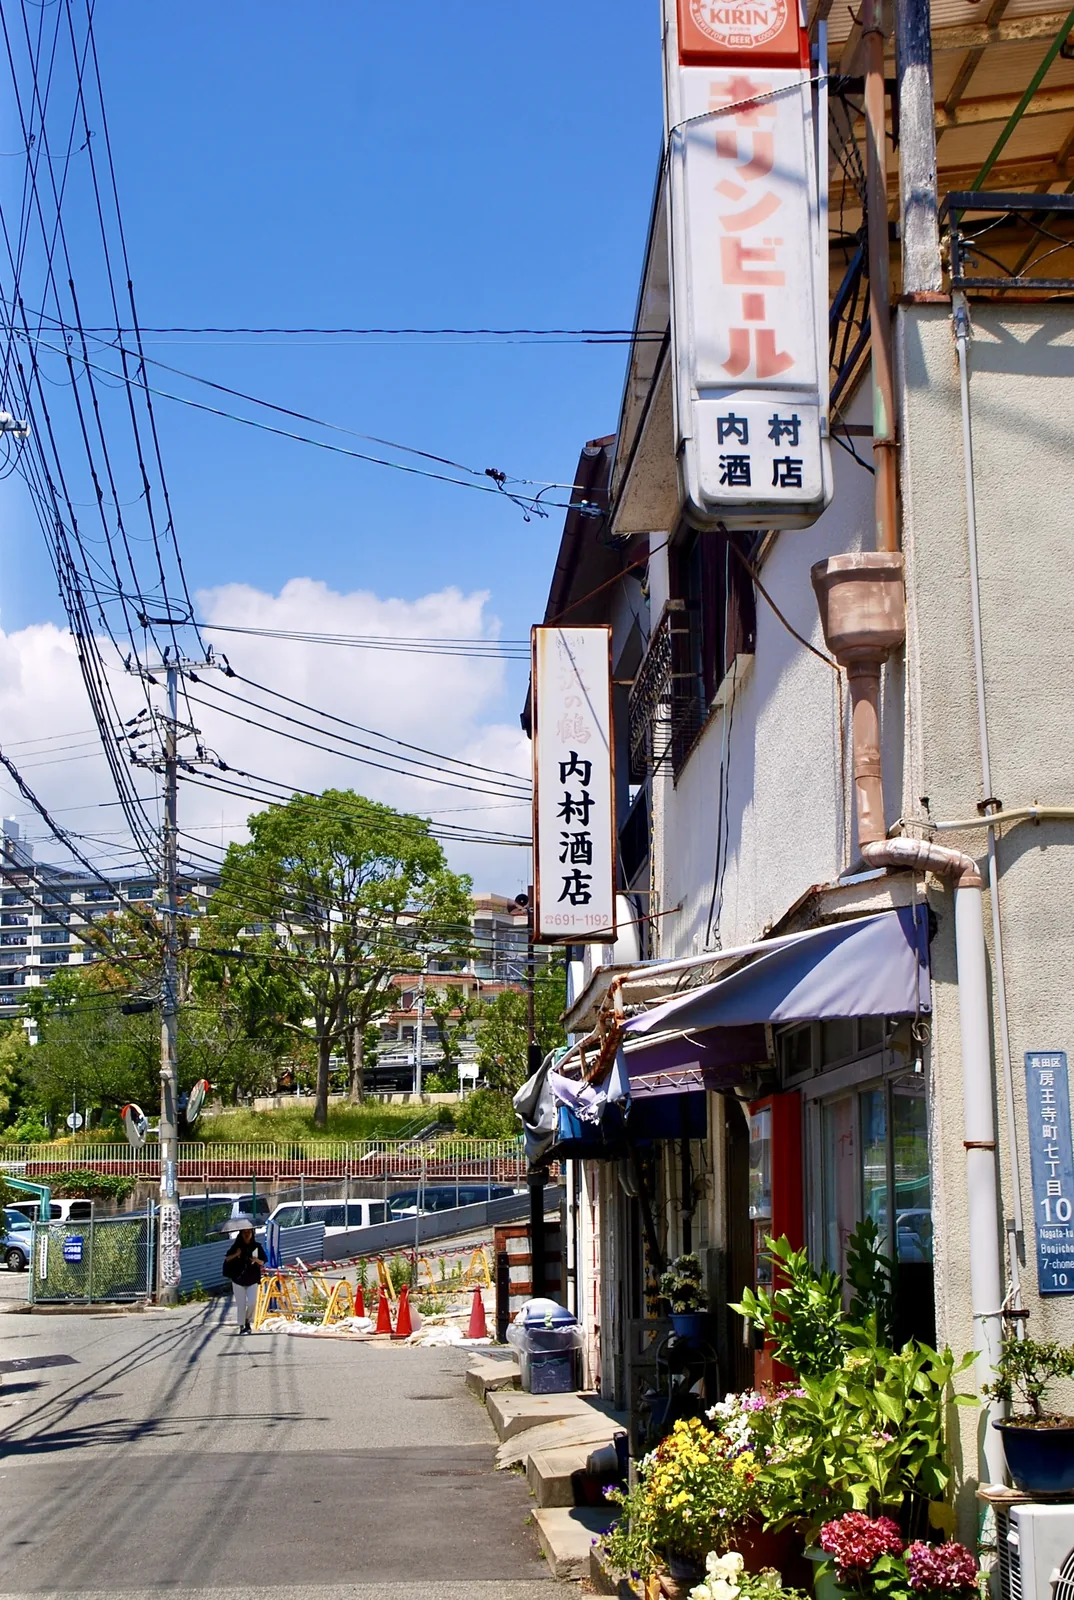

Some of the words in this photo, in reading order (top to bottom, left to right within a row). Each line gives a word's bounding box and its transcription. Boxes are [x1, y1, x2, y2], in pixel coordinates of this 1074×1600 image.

[709, 8, 769, 26] KIRIN
[730, 35, 751, 44] BEER
[708, 75, 796, 379] キリンビール
[716, 412, 802, 447] 内村
[718, 454, 804, 489] 酒店
[556, 750, 596, 907] 内村酒店
[1031, 1057, 1061, 1068] 長田区
[1038, 1070, 1062, 1196] 房王寺町七丁目
[1040, 1197, 1072, 1223] 10
[1040, 1228, 1074, 1240] Nagata-ku
[1042, 1258, 1074, 1270] 7-chome
[1051, 1273, 1068, 1286] 10
